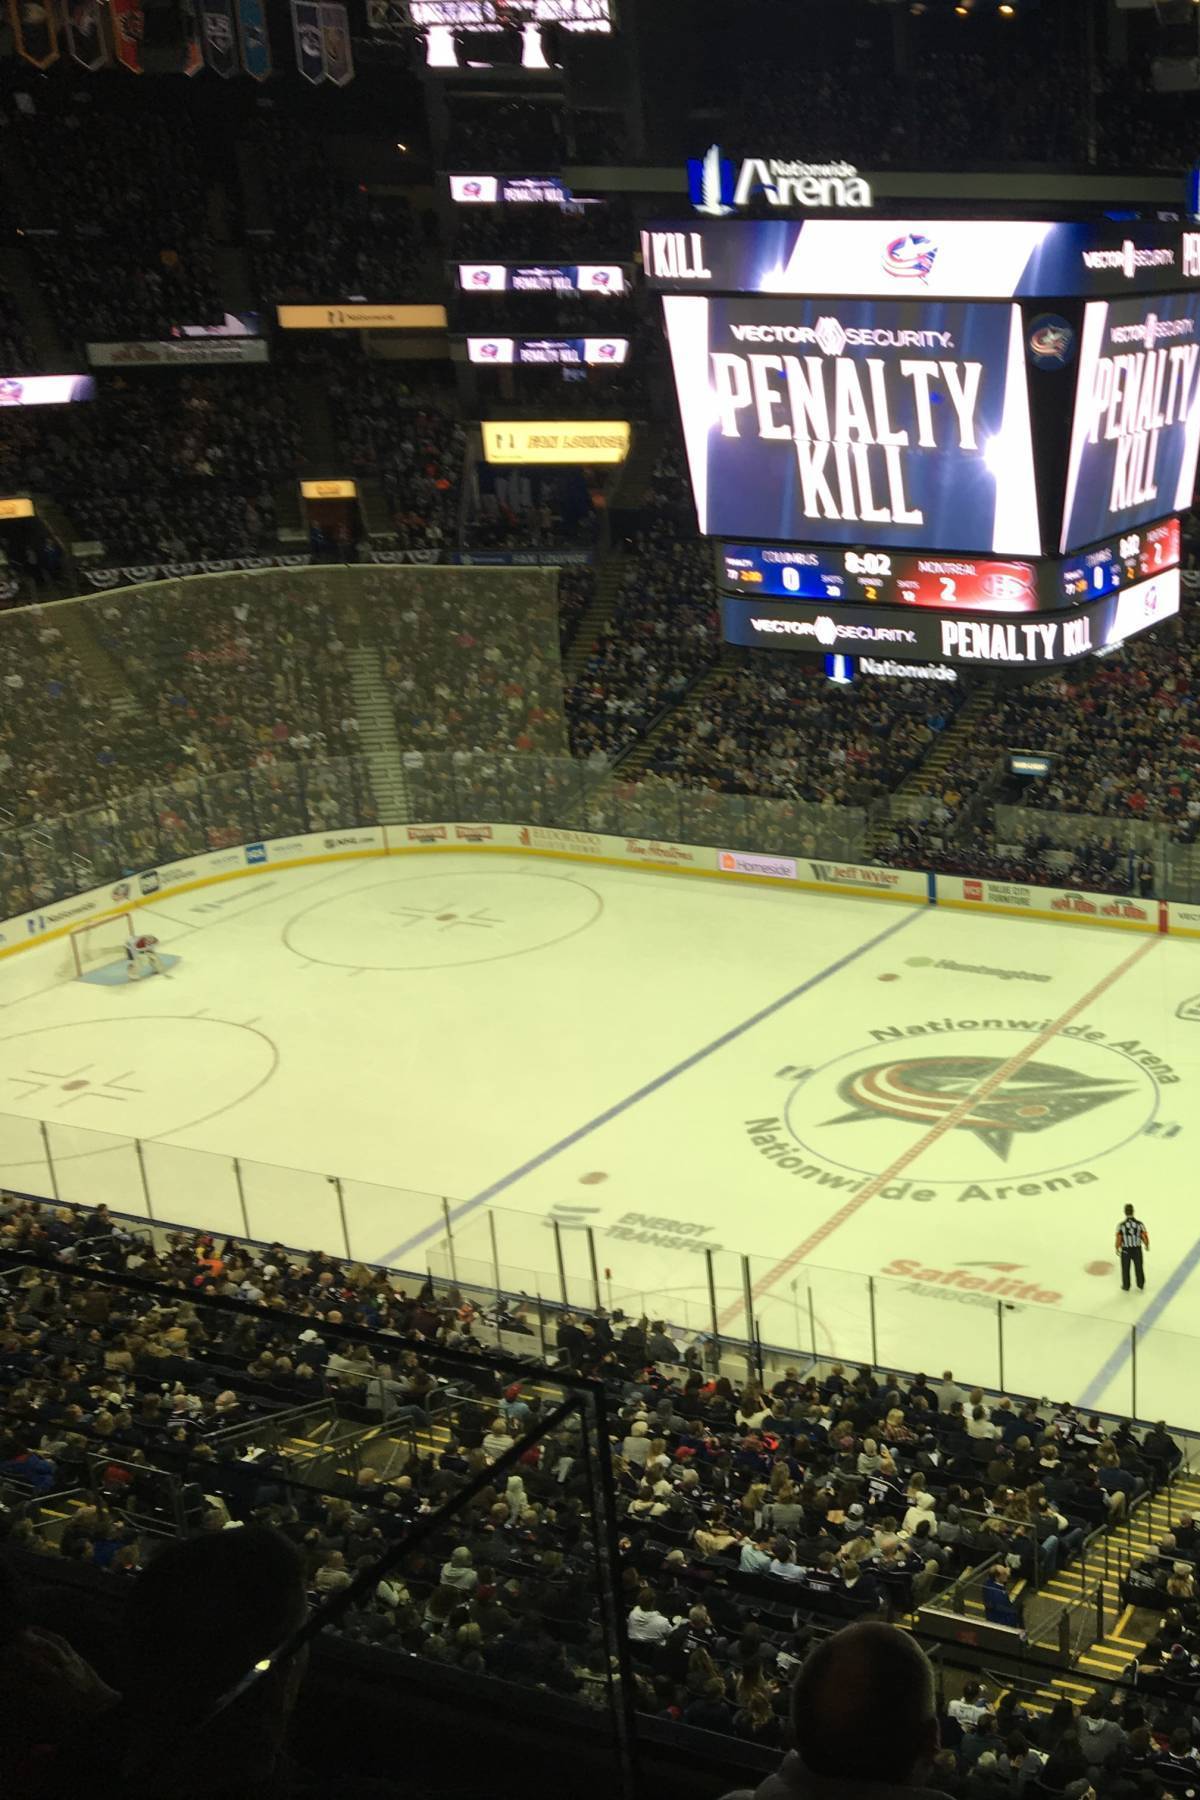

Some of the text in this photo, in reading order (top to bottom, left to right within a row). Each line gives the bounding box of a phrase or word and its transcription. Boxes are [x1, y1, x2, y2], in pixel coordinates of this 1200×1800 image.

[769, 159, 858, 178] Nationwide
[733, 158, 873, 207] Arena
[651, 232, 712, 278] KILL
[730, 324, 816, 343] VECTOR
[709, 352, 983, 450] PENALTY
[1088, 343, 1200, 444] PENALTY
[795, 439, 924, 525] KILL
[1109, 430, 1159, 513] KILL
[761, 550, 820, 567] COLUMBUS
[844, 551, 892, 577] 8:02
[917, 559, 978, 577] MONTREAL
[781, 566, 801, 592] 0
[938, 576, 957, 602] 2
[863, 585, 878, 601] 2
[751, 618, 815, 636] VECTOR
[940, 616, 1093, 661] PENALTY KILL
[859, 656, 959, 683] Nationwide
[736, 861, 792, 877] Homeside
[832, 866, 899, 886] Jeff Wyler
[934, 958, 1053, 984] Huntington
[868, 1016, 1182, 1086] Nationwide Arena
[744, 1116, 1101, 1203] Nationwide Arena
[617, 1211, 716, 1238] ENERGY
[880, 1258, 1064, 1306] Safelite
